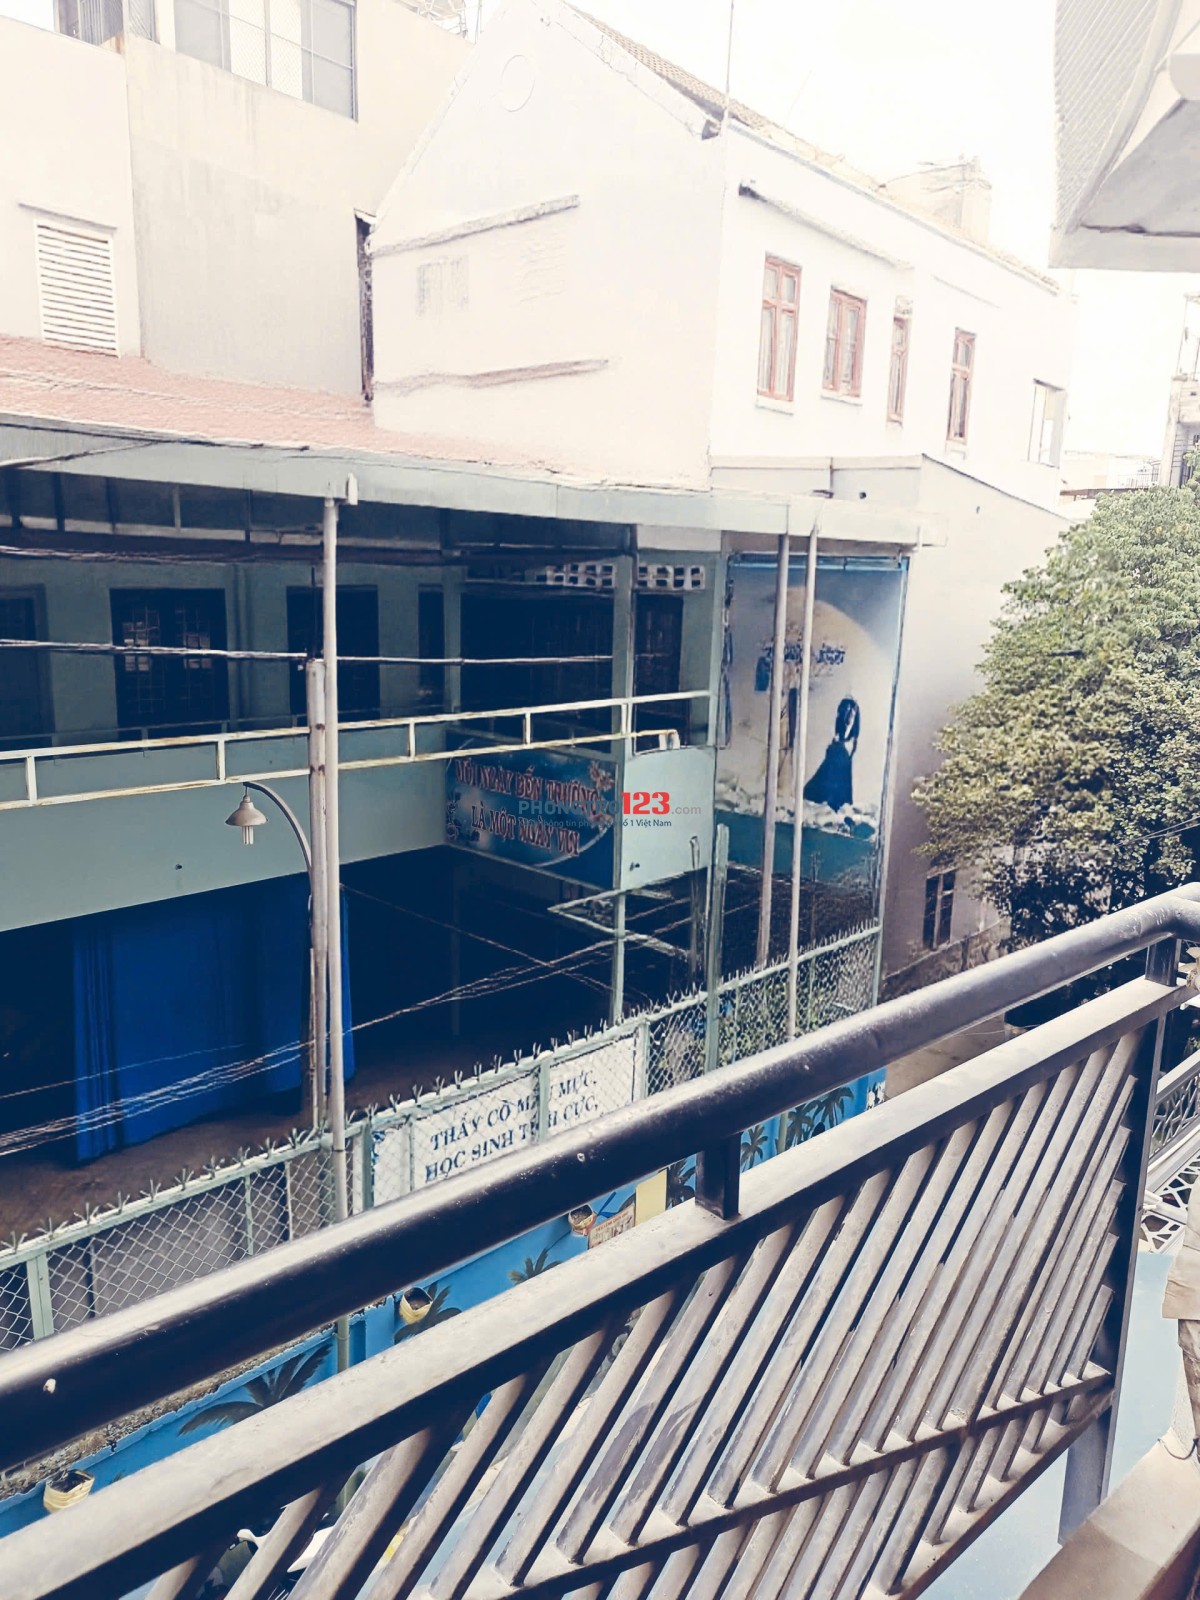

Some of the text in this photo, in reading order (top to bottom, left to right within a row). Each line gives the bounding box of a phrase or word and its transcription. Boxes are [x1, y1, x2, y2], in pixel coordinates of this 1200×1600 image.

[471, 800, 487, 831] LÀ
[425, 1150, 465, 1182] HỌC
[471, 1129, 514, 1161] SINH
